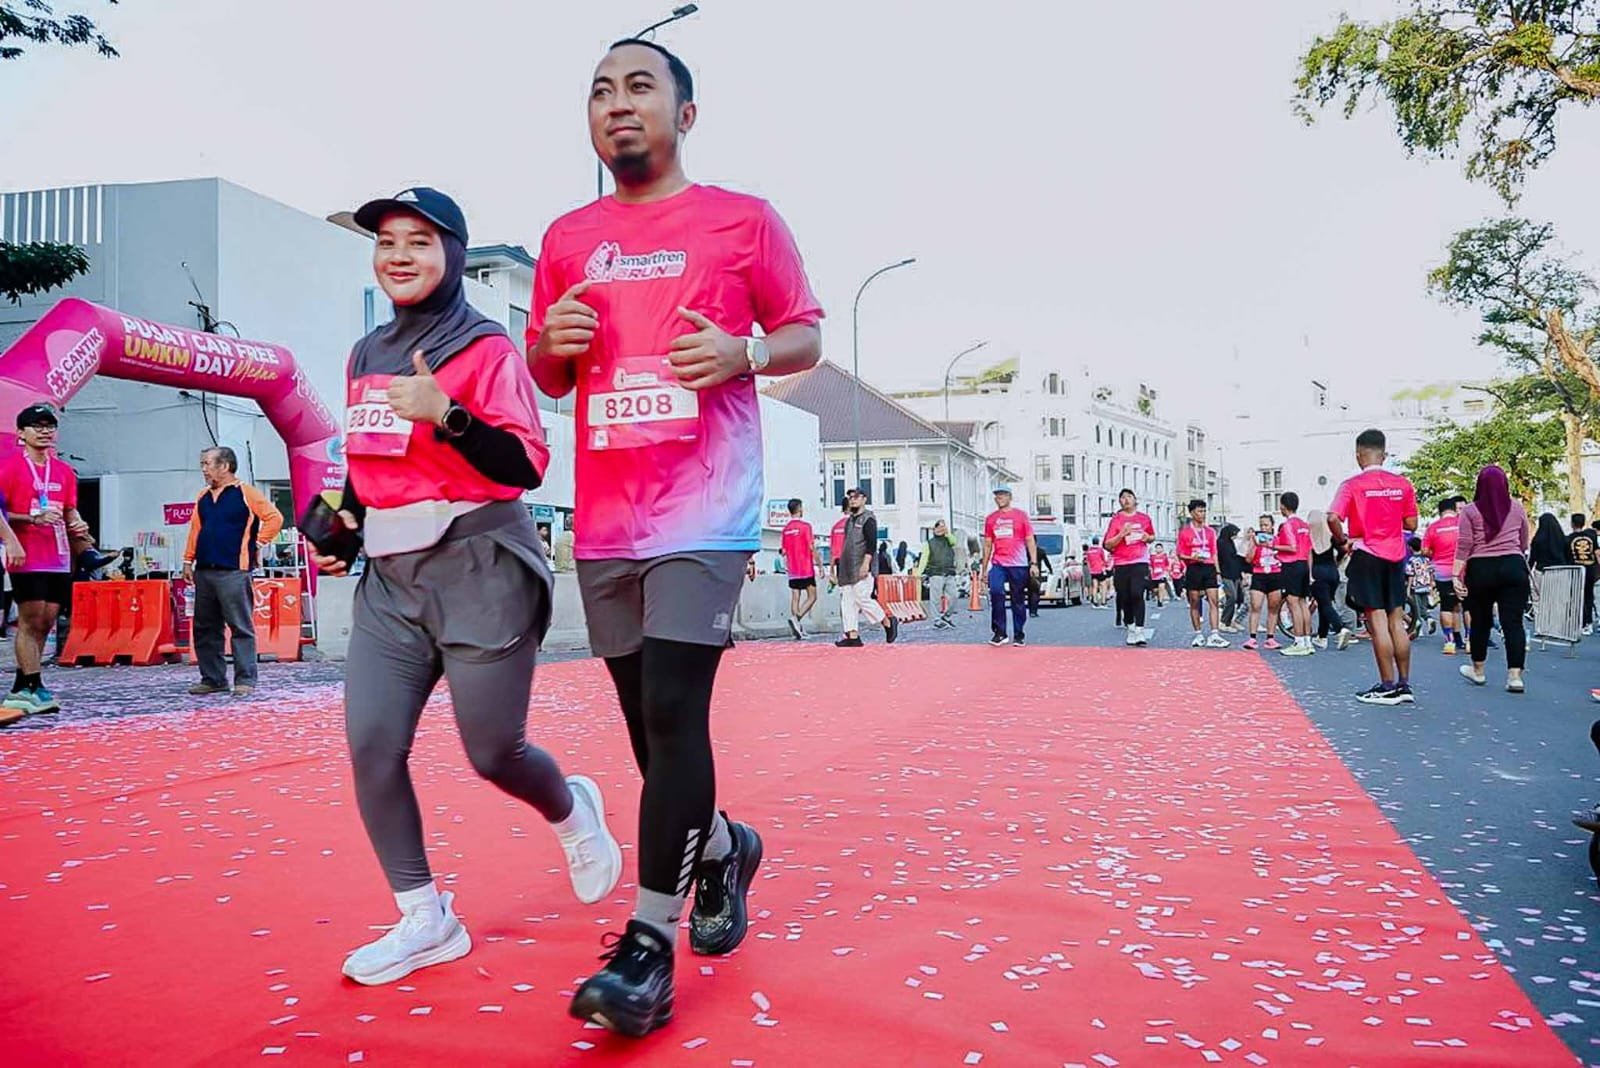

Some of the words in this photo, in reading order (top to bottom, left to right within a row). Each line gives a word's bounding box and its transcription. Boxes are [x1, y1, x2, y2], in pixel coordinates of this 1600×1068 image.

[620, 252, 685, 267] smartfren
[120, 316, 188, 347] PUSAT
[124, 335, 190, 368] UMKM
[191, 334, 235, 358] CAR
[235, 343, 280, 365] FREE
[194, 352, 236, 377] DAY
[70, 350, 98, 384] CUAN
[605, 393, 673, 419] 8208
